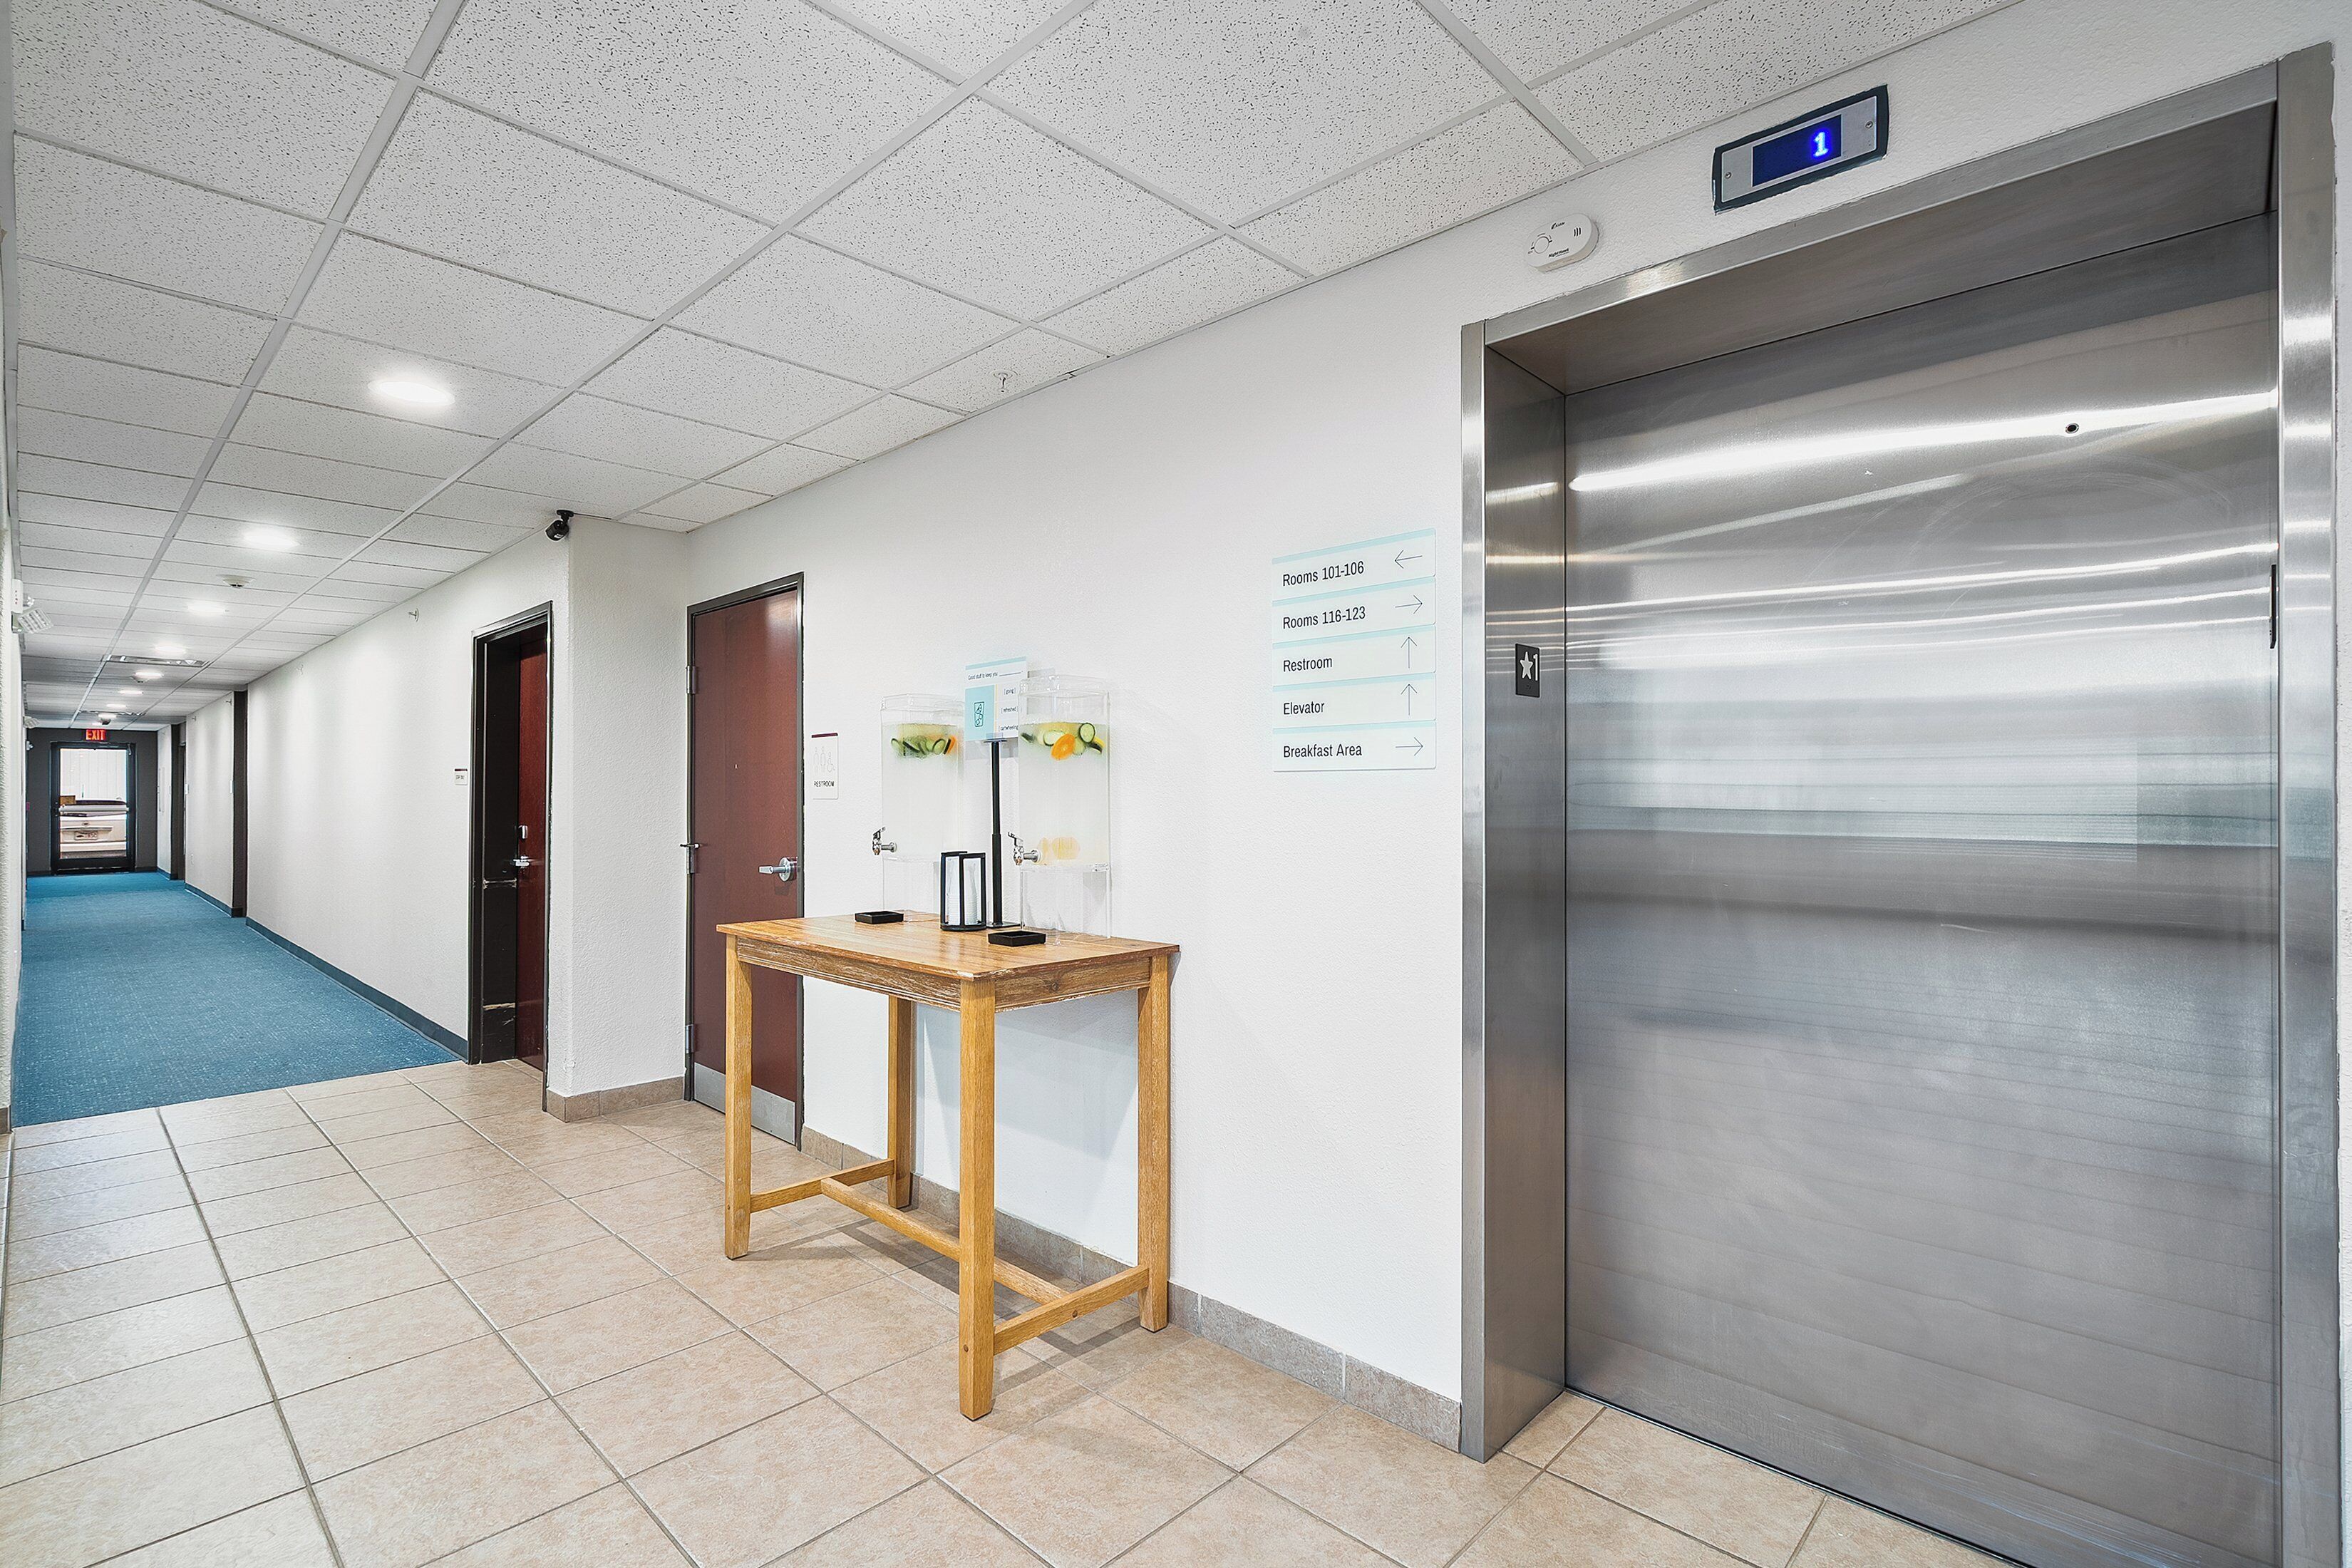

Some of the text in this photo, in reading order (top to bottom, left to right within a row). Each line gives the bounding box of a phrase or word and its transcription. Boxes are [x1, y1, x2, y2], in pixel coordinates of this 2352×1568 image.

[1814, 132, 1829, 157] 1
[1282, 560, 1365, 587] Rooms 101-106
[1282, 606, 1366, 629] Rooms 116-123
[1283, 657, 1333, 672] Restroom
[1283, 701, 1325, 715] Elevator
[86, 729, 105, 741] EXIT
[1283, 743, 1363, 758] Breakfast Area
